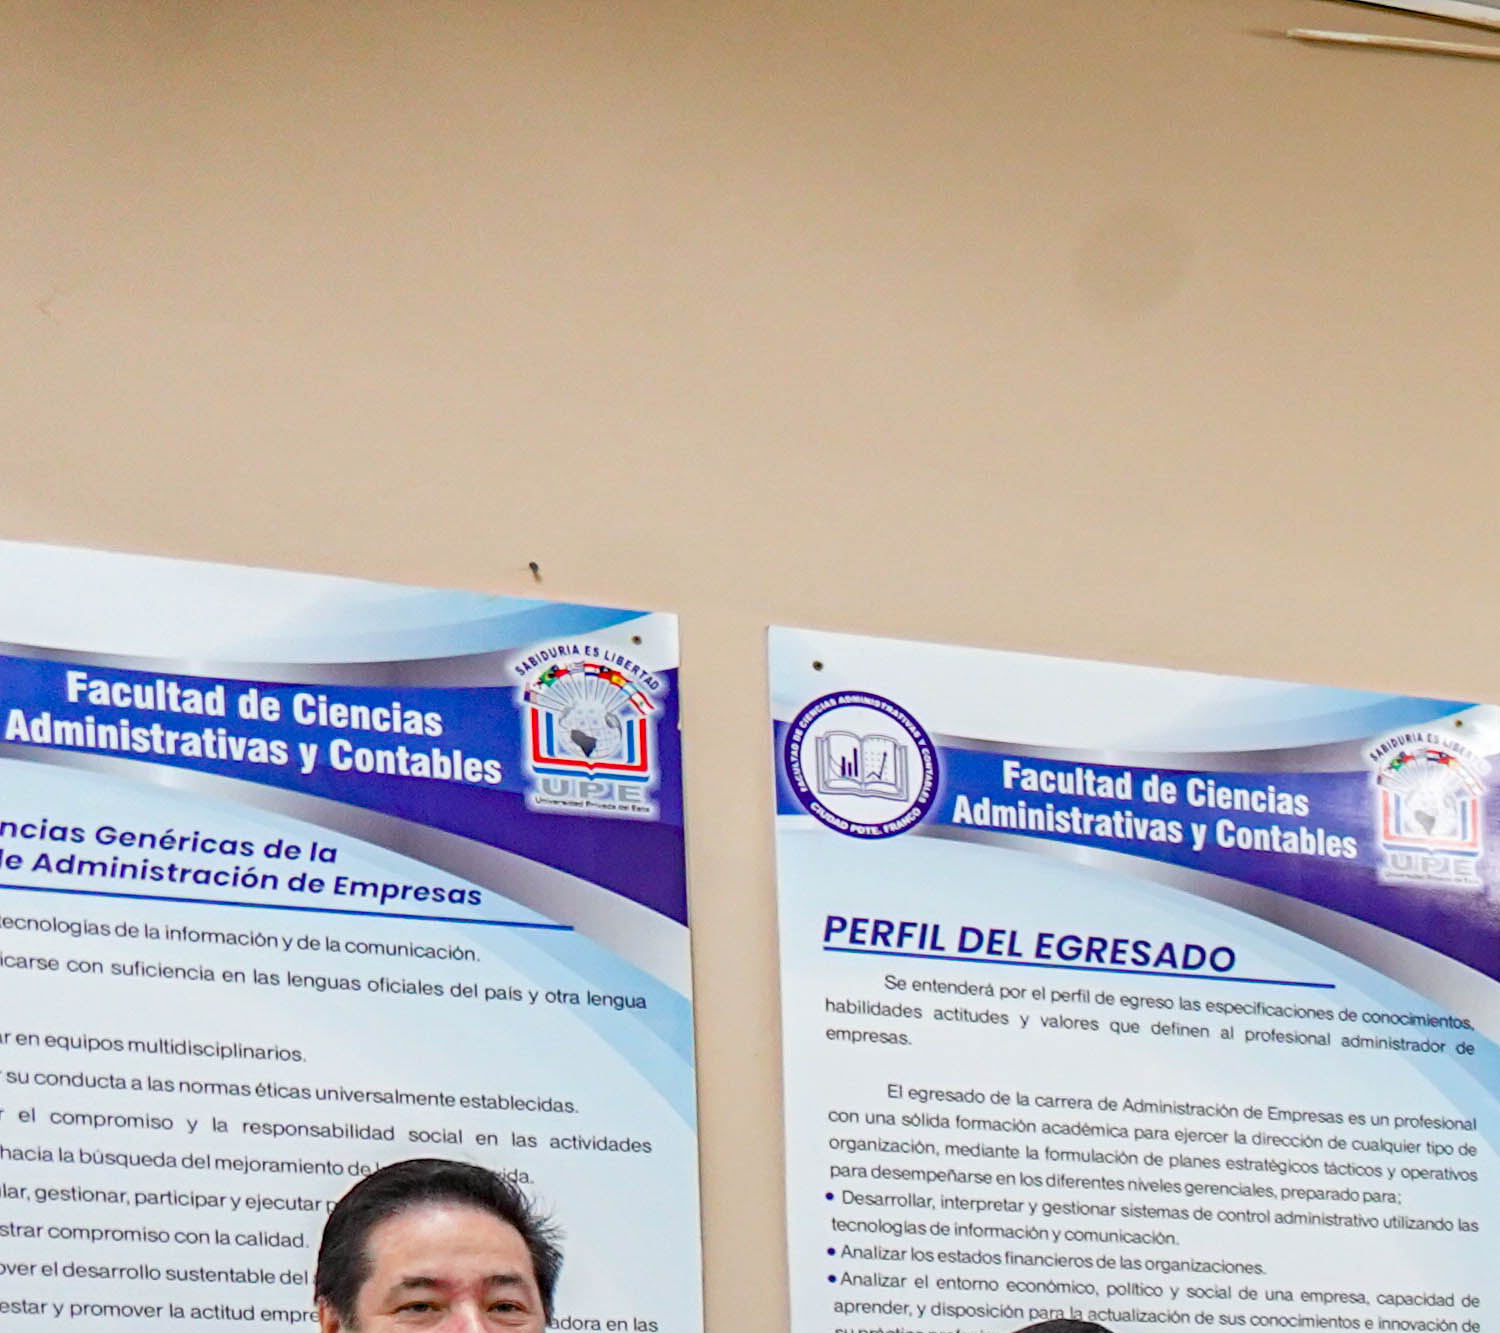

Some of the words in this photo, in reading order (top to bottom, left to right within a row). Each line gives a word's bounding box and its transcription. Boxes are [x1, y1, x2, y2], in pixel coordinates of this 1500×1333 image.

[585, 645, 600, 657] ES
[66, 670, 225, 717] Facultad
[238, 688, 280, 722] de
[292, 692, 443, 737] Ciencias
[4, 708, 288, 765] Administrativas
[298, 742, 318, 774] y
[329, 738, 502, 784] Contables
[542, 778, 641, 804] UPE
[1003, 759, 1132, 800] Facultad
[1142, 773, 1177, 805] de
[1186, 777, 1309, 816] Ciencias
[0, 817, 85, 843] ncias
[95, 825, 254, 857] Genéricas
[263, 838, 301, 860] de
[309, 841, 337, 863] la
[952, 794, 1183, 843] Administrativas
[1190, 822, 1207, 851] y
[1215, 818, 1357, 858] Contables
[31, 852, 278, 890] Administración
[287, 871, 325, 893] de
[333, 875, 481, 905] Empresas
[114, 921, 139, 938] de
[144, 922, 160, 940] la
[165, 924, 278, 948] información
[281, 936, 293, 952] y
[296, 934, 320, 951] de
[325, 935, 341, 952] la
[344, 941, 480, 962] comunicación.
[823, 914, 945, 951] PERFIL
[957, 926, 1022, 957] DEL
[1034, 932, 1235, 972] EGRESADO
[0, 951, 59, 971] icarse
[66, 959, 103, 974] con
[111, 960, 215, 981] suficiencia
[221, 970, 245, 983] en
[253, 967, 280, 986] las
[287, 970, 361, 992] lenguas
[367, 976, 444, 996] oficiales
[449, 982, 478, 998] del
[527, 989, 539, 1005] y
[544, 988, 580, 1005] otra
[586, 989, 647, 1011] lengua
[884, 974, 907, 991] Se
[911, 978, 994, 997] entenderá
[999, 986, 1027, 1000] por
[1031, 985, 1045, 1000] el
[1050, 988, 1090, 1004] perfil
[1094, 990, 1115, 1006] de
[1119, 995, 1174, 1010] egreso
[1178, 995, 1201, 1012] las
[1205, 1000, 1334, 1021] especificaciones
[1337, 1007, 1358, 1022] de
[1361, 1011, 1475, 1032] conocimientos,
